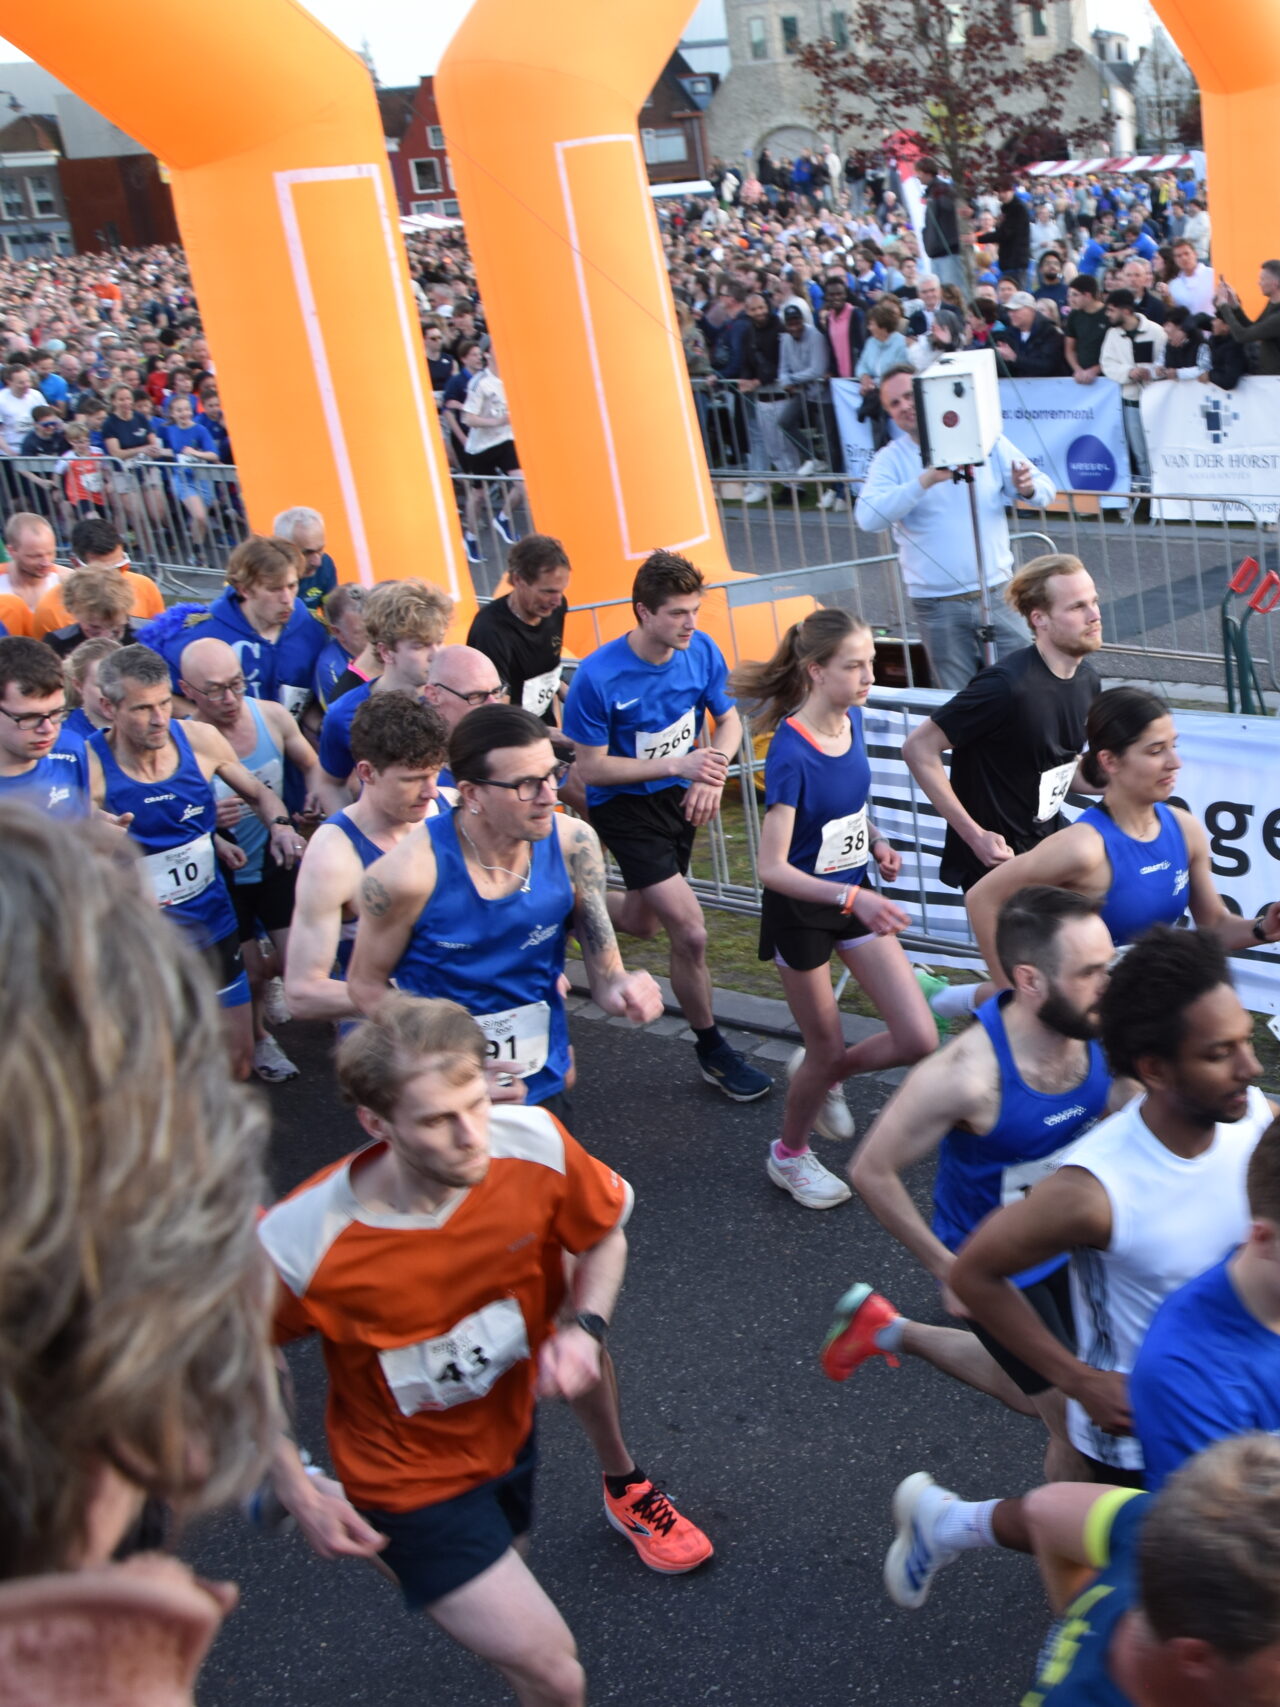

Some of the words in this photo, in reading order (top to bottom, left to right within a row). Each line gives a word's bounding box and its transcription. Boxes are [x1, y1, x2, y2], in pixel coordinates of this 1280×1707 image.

[1162, 455, 1190, 468] VAN
[1195, 455, 1225, 469] DER
[1229, 455, 1280, 469] HORST
[841, 830, 865, 855] 38
[168, 862, 198, 886] 10
